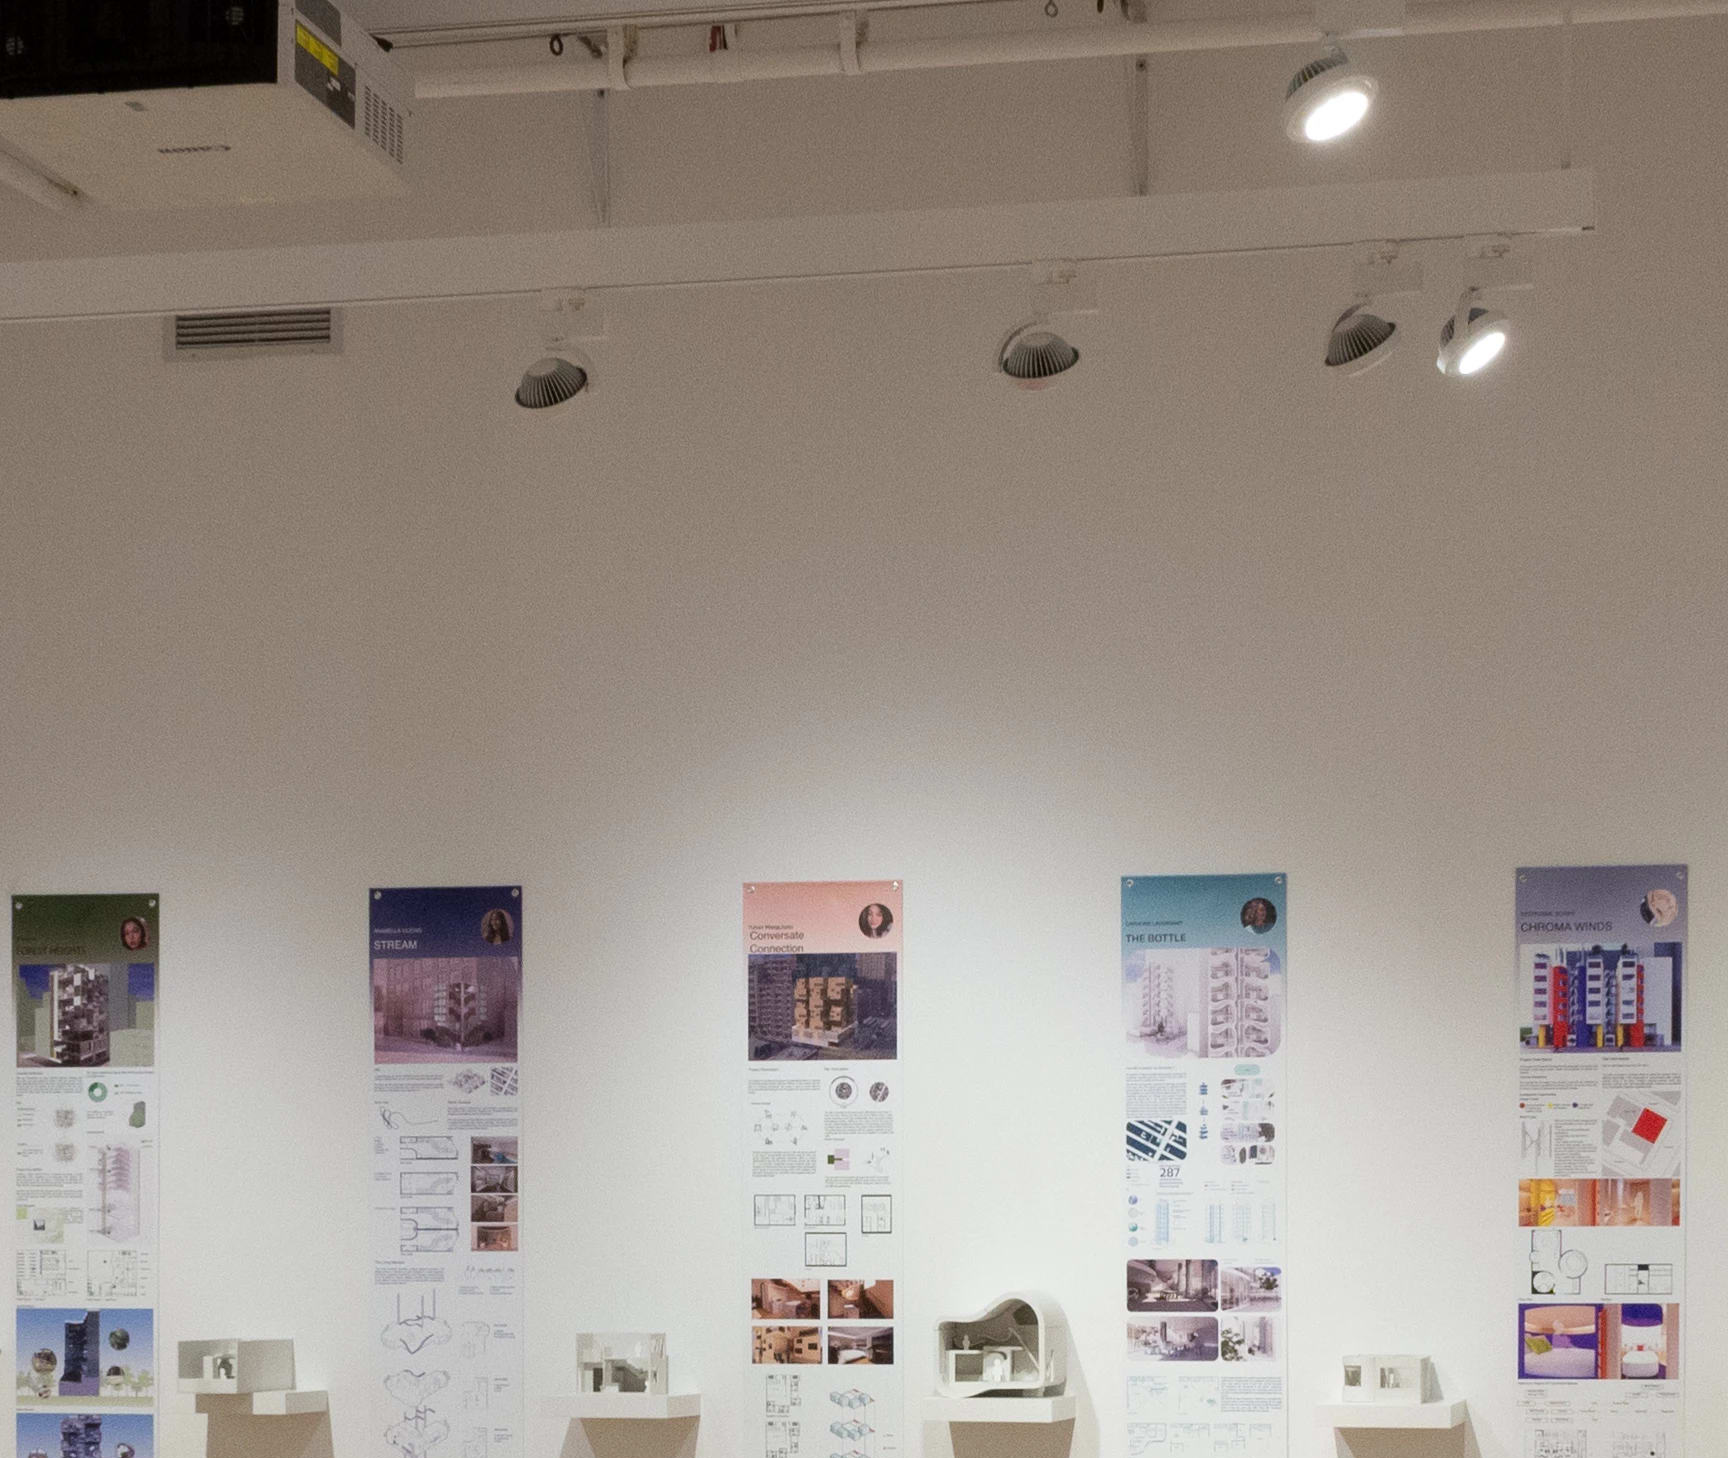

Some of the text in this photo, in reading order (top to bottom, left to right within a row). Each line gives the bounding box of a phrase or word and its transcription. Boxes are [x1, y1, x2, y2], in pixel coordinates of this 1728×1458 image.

[1520, 921, 1613, 932] CHROMA WINDS
[749, 931, 805, 941] Conversate
[1125, 933, 1187, 943] THE BOTTLE
[373, 940, 418, 950] STREAM
[749, 943, 804, 953] Connection
[1159, 1167, 1181, 1178] 287
